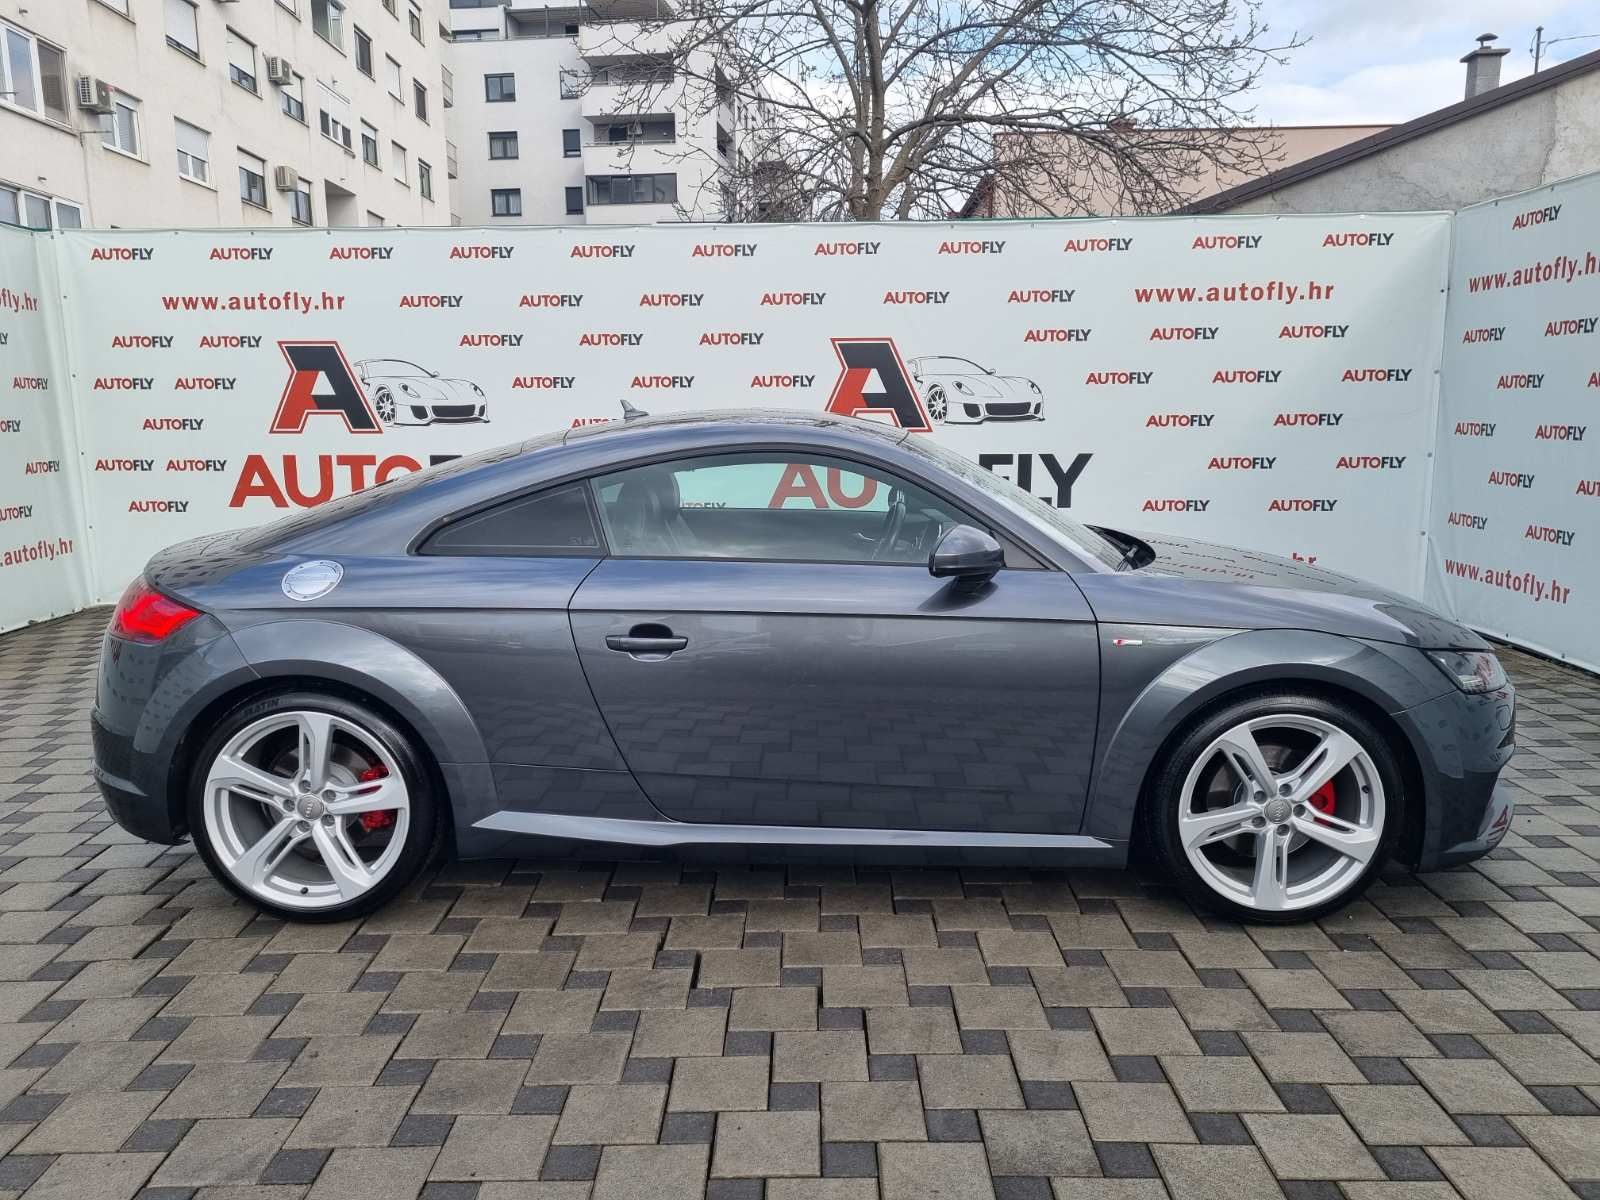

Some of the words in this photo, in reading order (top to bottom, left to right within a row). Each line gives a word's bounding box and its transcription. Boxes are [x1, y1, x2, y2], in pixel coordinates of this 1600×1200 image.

[1512, 204, 1562, 230] AUTOFLY
[1064, 238, 1133, 252] AUTOFLY
[1192, 236, 1262, 249] AUTOFLY
[1322, 233, 1394, 247] AUTOFLY
[91, 248, 154, 260] AUTOFLY
[210, 248, 273, 260] AUTOFLY
[330, 247, 393, 259] AUTOFLY
[450, 246, 514, 259] AUTOFLY
[570, 245, 635, 258] AUTOFLY
[692, 244, 757, 257] AUTOFLY
[815, 242, 880, 255] AUTOFLY
[938, 241, 1006, 254] AUTOFLY
[760, 293, 826, 305] AUTOFLY
[883, 291, 950, 304] AUTOFLY
[1008, 290, 1075, 303] AUTOFLY
[1135, 281, 1334, 304] www.autofly.hr
[162, 292, 346, 314] www.autofly.hr
[400, 296, 463, 307] AUTOFLY
[519, 295, 583, 307] AUTOFLY
[640, 294, 704, 306] AUTOFLY
[1279, 325, 1349, 338] AUTOFLY
[1545, 317, 1598, 336] AUTOFLY
[459, 334, 524, 346] AUTOFLY
[579, 334, 643, 346] AUTOFLY
[699, 333, 764, 345] AUTOFLY
[1024, 329, 1091, 342] AUTOFLY
[1150, 327, 1219, 340] AUTOFLY
[1463, 327, 1506, 344] AUTOFLY
[112, 336, 174, 348] AUTOFLY
[200, 336, 262, 348] AUTOFLY
[631, 376, 695, 388] AUTOFLY
[751, 375, 815, 388] AUTOFLY
[1085, 372, 1153, 384] AUTOFLY
[1212, 370, 1282, 383] AUTOFLY
[1342, 369, 1412, 382] AUTOFLY
[1497, 374, 1544, 389] AUTOFLY
[13, 377, 48, 390] AUTOFLY
[94, 378, 154, 390] AUTOFLY
[174, 378, 236, 390] AUTOFLY
[512, 377, 575, 388] AUTOFLY
[143, 419, 204, 430] AUTOFLY
[1146, 415, 1215, 427] AUTOFLY
[1273, 413, 1344, 426] AUTOFLY
[1454, 423, 1496, 437] AUTOFLY
[1535, 425, 1587, 441] AUTOFLY
[26, 460, 59, 474] AUTOFLY
[95, 459, 154, 471] AUTOFLY
[166, 460, 227, 471] AUTOFLY
[1208, 457, 1276, 469] AUTOFLY
[1336, 457, 1406, 468] AUTOFLY
[1488, 472, 1535, 488] AUTOFLY
[128, 501, 189, 512] AUTOFLY
[1142, 500, 1210, 512] AUTOFLY
[1268, 500, 1338, 511] AUTOFLY
[1448, 512, 1487, 530] AUTOFLY
[1525, 525, 1575, 546] AUTOFLY
[1445, 559, 1570, 603] www.autofly.hr
